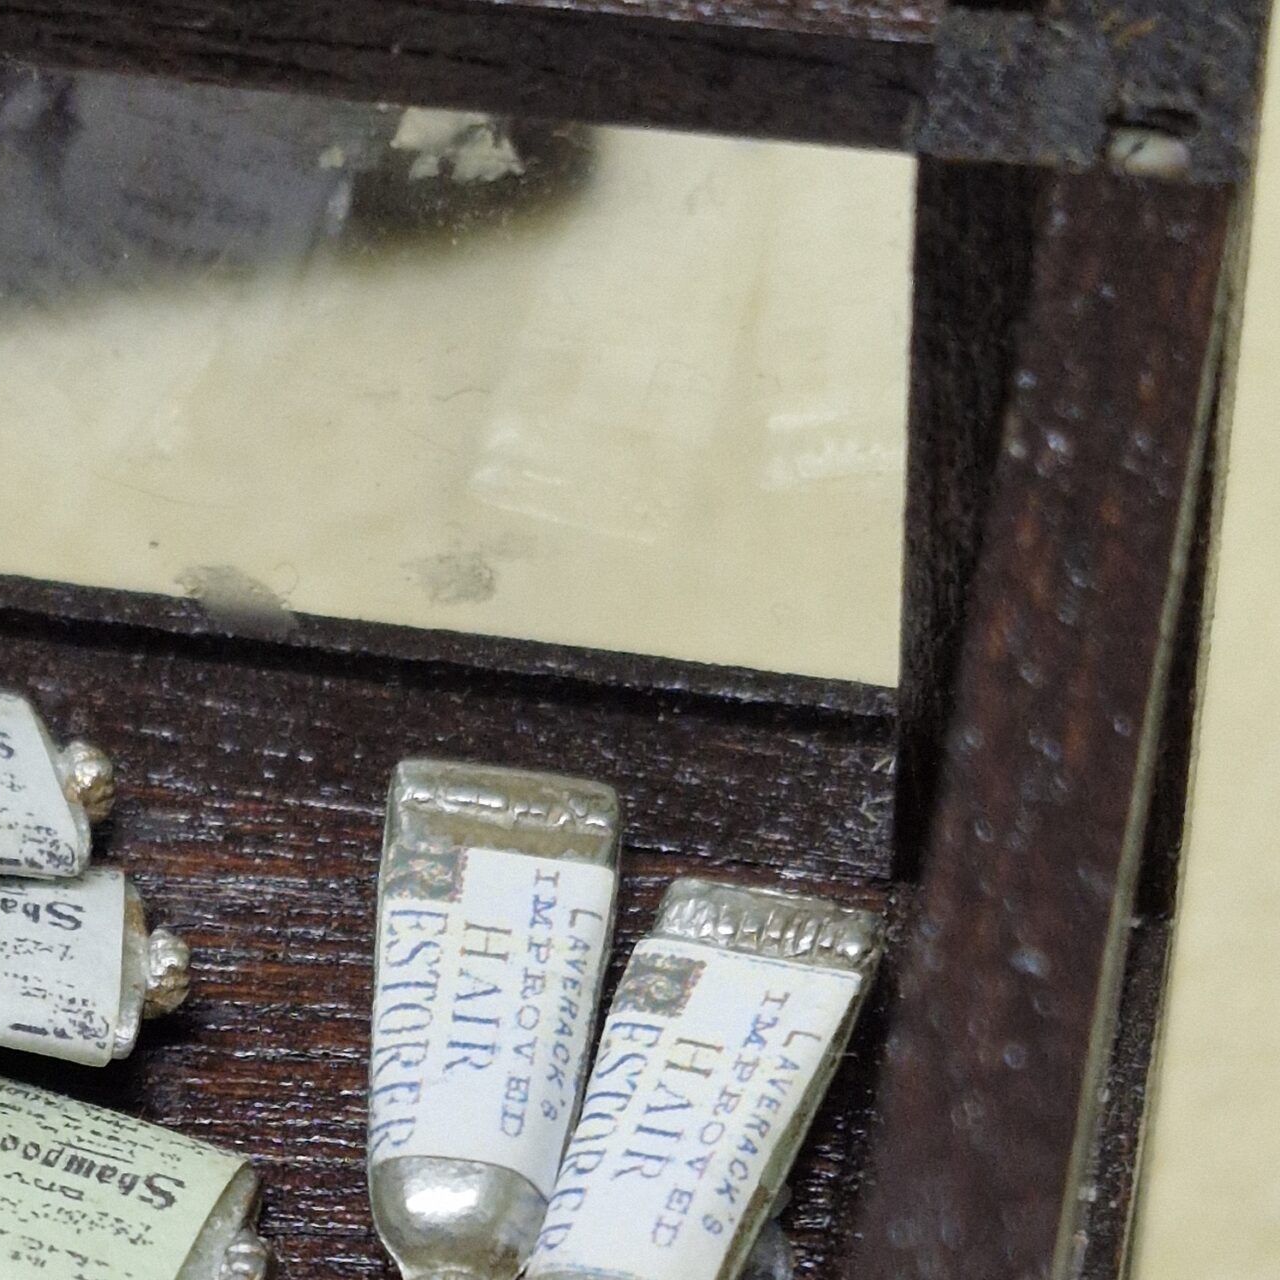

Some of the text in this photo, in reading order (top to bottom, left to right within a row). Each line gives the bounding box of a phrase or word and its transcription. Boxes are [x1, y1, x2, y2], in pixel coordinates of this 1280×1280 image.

[443, 921, 512, 1076] HAIR
[501, 867, 560, 1137] IMPROVED
[610, 1036, 724, 1183] HAIR
[651, 990, 790, 1249] IMPROVED
